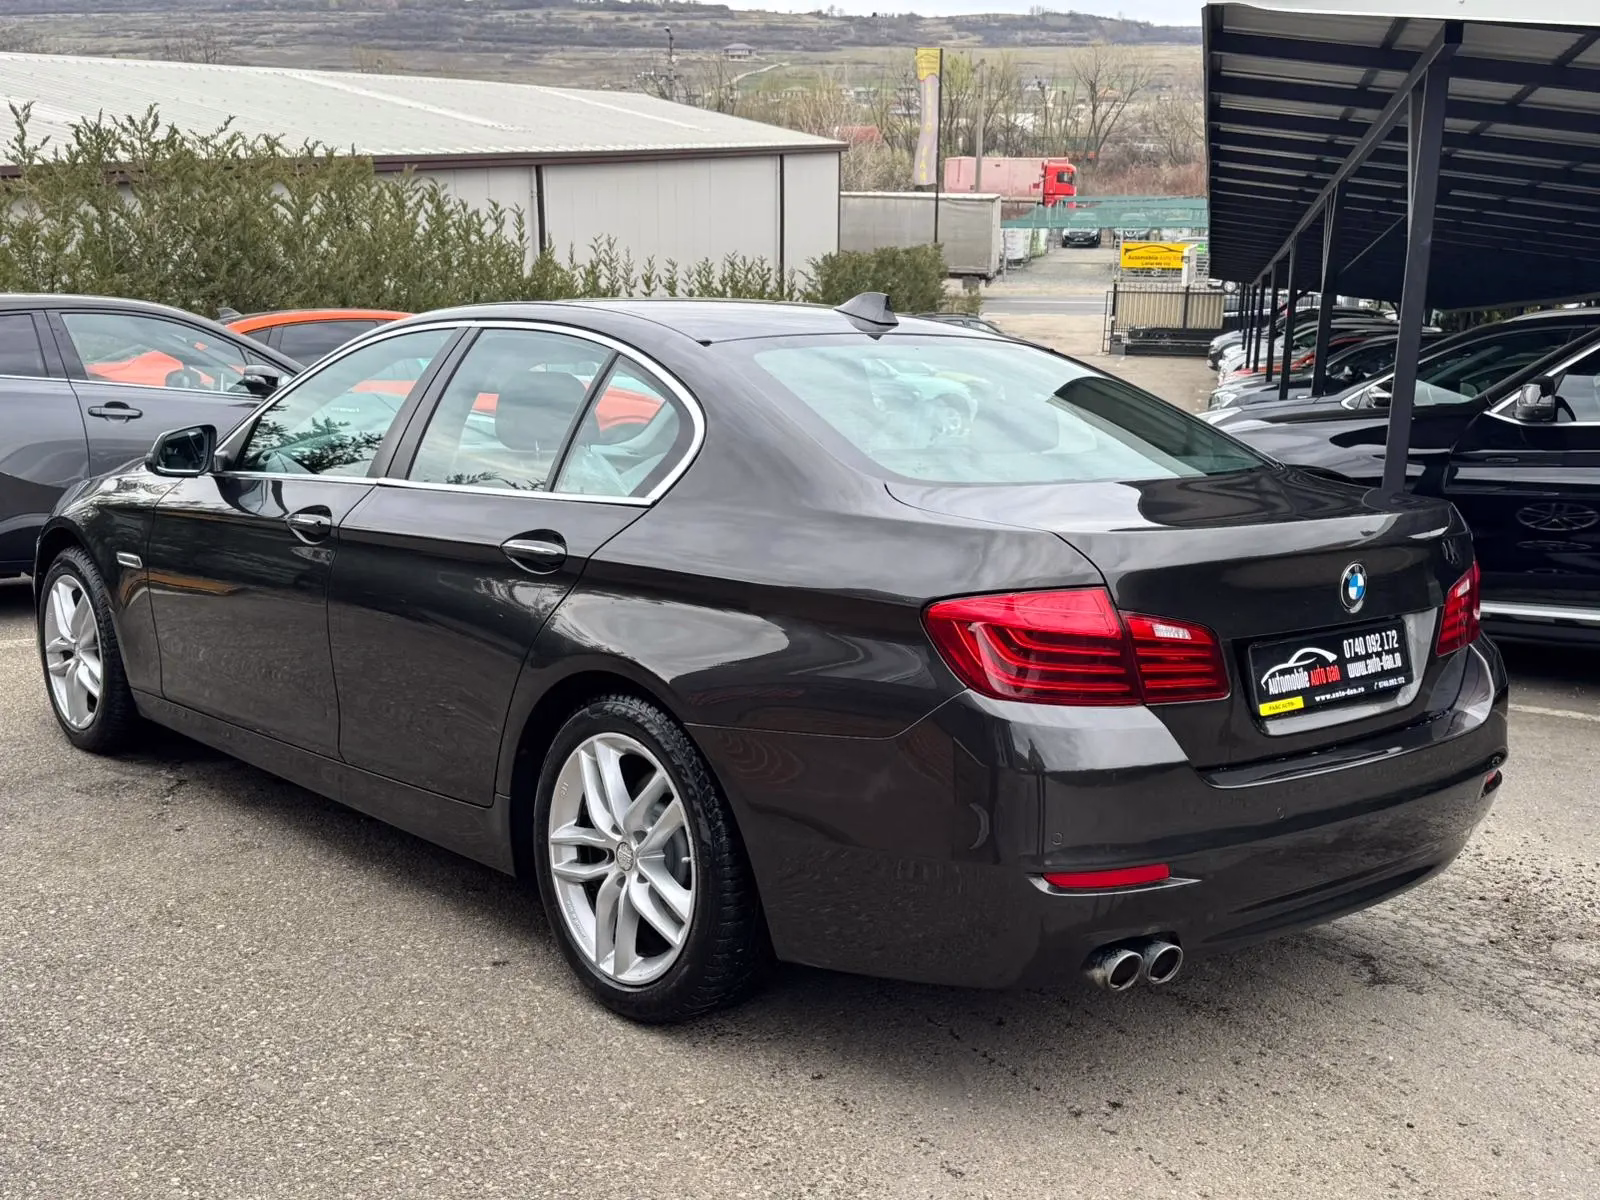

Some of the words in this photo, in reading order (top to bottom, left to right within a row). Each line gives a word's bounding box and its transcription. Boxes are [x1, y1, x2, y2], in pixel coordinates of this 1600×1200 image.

[1343, 636, 1366, 659] 0740
[1365, 633, 1382, 654] 092
[1381, 629, 1399, 650] 172
[1346, 651, 1402, 679] www.auto-dan.ro
[1314, 686, 1365, 702] www.auto-dan.ro
